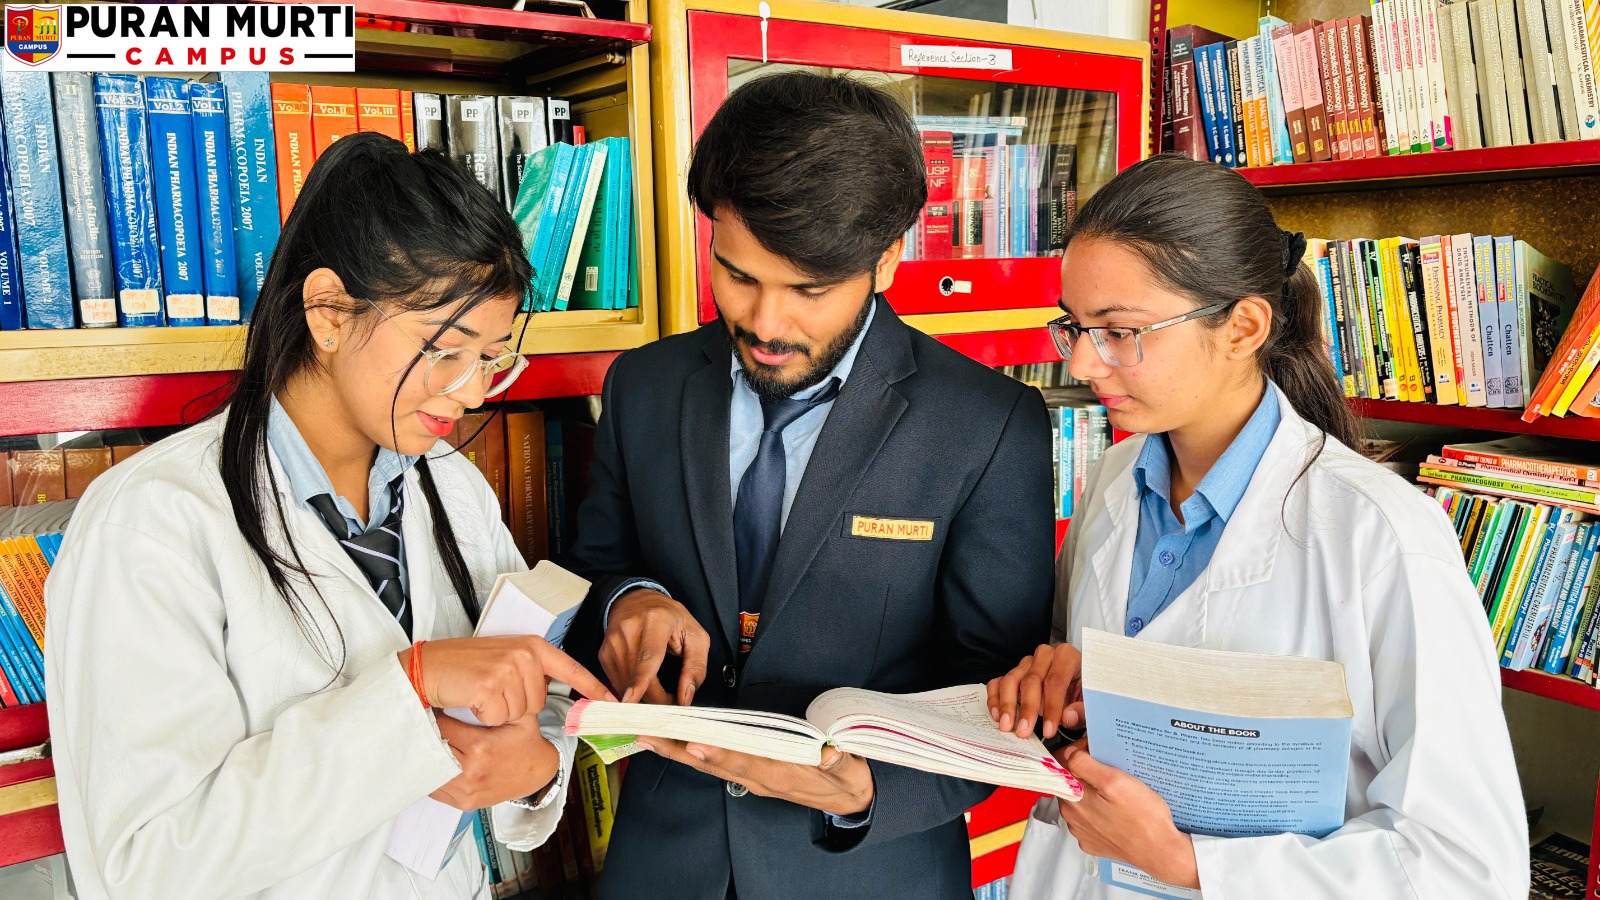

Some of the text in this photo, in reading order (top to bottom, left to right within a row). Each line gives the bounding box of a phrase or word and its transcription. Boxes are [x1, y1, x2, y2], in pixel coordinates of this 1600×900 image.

[908, 48, 948, 65] Reference
[1231, 48, 1240, 90] Pharmaceutical
[1241, 43, 1253, 97] PHARMACEUTICAL
[1287, 47, 1299, 104] Pharmacology
[1306, 41, 1318, 101] Pharmacology
[1327, 28, 1343, 113] Pharmaceutical Technology
[1340, 26, 1356, 110] Pharmaceutical Technology
[1353, 24, 1369, 108] Pharmaceutical Technology
[1577, 16, 1595, 108] PHARMACEUTICAL CHEMISTRY
[65, 85, 78, 95] II
[1253, 38, 1265, 94] PHARMACEUTICAL
[1259, 99, 1268, 129] ANALYSIS
[153, 102, 185, 111] Vol.2
[192, 101, 222, 110] Vol.1
[320, 105, 347, 115] Vol.II
[363, 106, 394, 115] Vol.III
[35, 124, 51, 174] INDIAN
[118, 127, 131, 166] INDIAN
[166, 132, 180, 169] INDIAN
[204, 130, 217, 167] INDIAN
[231, 91, 253, 231] PHARMACOPOEIA 2007
[254, 137, 268, 183] INDIAN
[288, 132, 301, 167] INDIAN
[73, 110, 100, 241] Pharmacopoeia of India
[926, 166, 950, 176] USP
[929, 179, 946, 188] NF
[22, 200, 36, 227] 2007
[169, 170, 187, 258] PHARMACOPOEIA
[0, 251, 11, 296] VOLUME
[38, 249, 52, 294] VOLUME
[177, 261, 189, 281] 2007
[1475, 243, 1484, 283] Chemistry
[1483, 242, 1494, 303] Pharmaceutical
[1497, 243, 1505, 283] Chemistry
[1504, 242, 1515, 303] Pharmaceutical
[1329, 247, 1338, 277] Principles
[1334, 285, 1344, 322] Microbiology
[1431, 266, 1445, 340] DISPENSING PHARMACY
[1457, 268, 1466, 301] ANALYSIS
[1463, 247, 1477, 343] INSTRUMENTAL METHODS OF
[1444, 245, 1463, 369] COMPREHENSIVE BIOCHEMISTRY
[1485, 325, 1494, 357] Chatten
[1504, 324, 1512, 356] Chatten
[1093, 433, 1102, 460] Physical
[1464, 455, 1578, 478] CURRENT TRENDS PHARMACOTHERAPEUTICS
[1450, 475, 1505, 488] PHARMACOGNOSY
[1480, 464, 1576, 483] Pharmaceutical Chemistry-I Part-I
[523, 434, 536, 560] NATIONAL FORMULARY OF INDIA
[857, 521, 929, 537] PURAN MURTI
[14, 553, 37, 591] HOSPITAL AND
[25, 552, 42, 577] HOSPITAL
[1533, 538, 1551, 581] Pharmaceutical
[1539, 546, 1560, 597] PHARMACEUTICAL
[1551, 526, 1586, 630] ANANT PHARMACOLOGY AND TOXICOLOGY
[2, 553, 19, 580] HOSPITAL
[15, 578, 26, 591] AND
[22, 590, 38, 614] CLINICAL
[1521, 581, 1537, 615] Chemistry-I
[1557, 534, 1597, 639] ANANT PHARMACEUTICAL CHEMISTRY-I
[1583, 590, 1595, 612] BUSINESS
[4, 581, 14, 593] AND
[10, 591, 27, 615] CLINICAL
[23, 613, 42, 641] PHARMACY
[1522, 596, 1543, 640] CHEMISTRY-II
[1173, 720, 1206, 732] ABOUT
[1207, 726, 1227, 735] THE
[1228, 728, 1257, 737] BOOK
